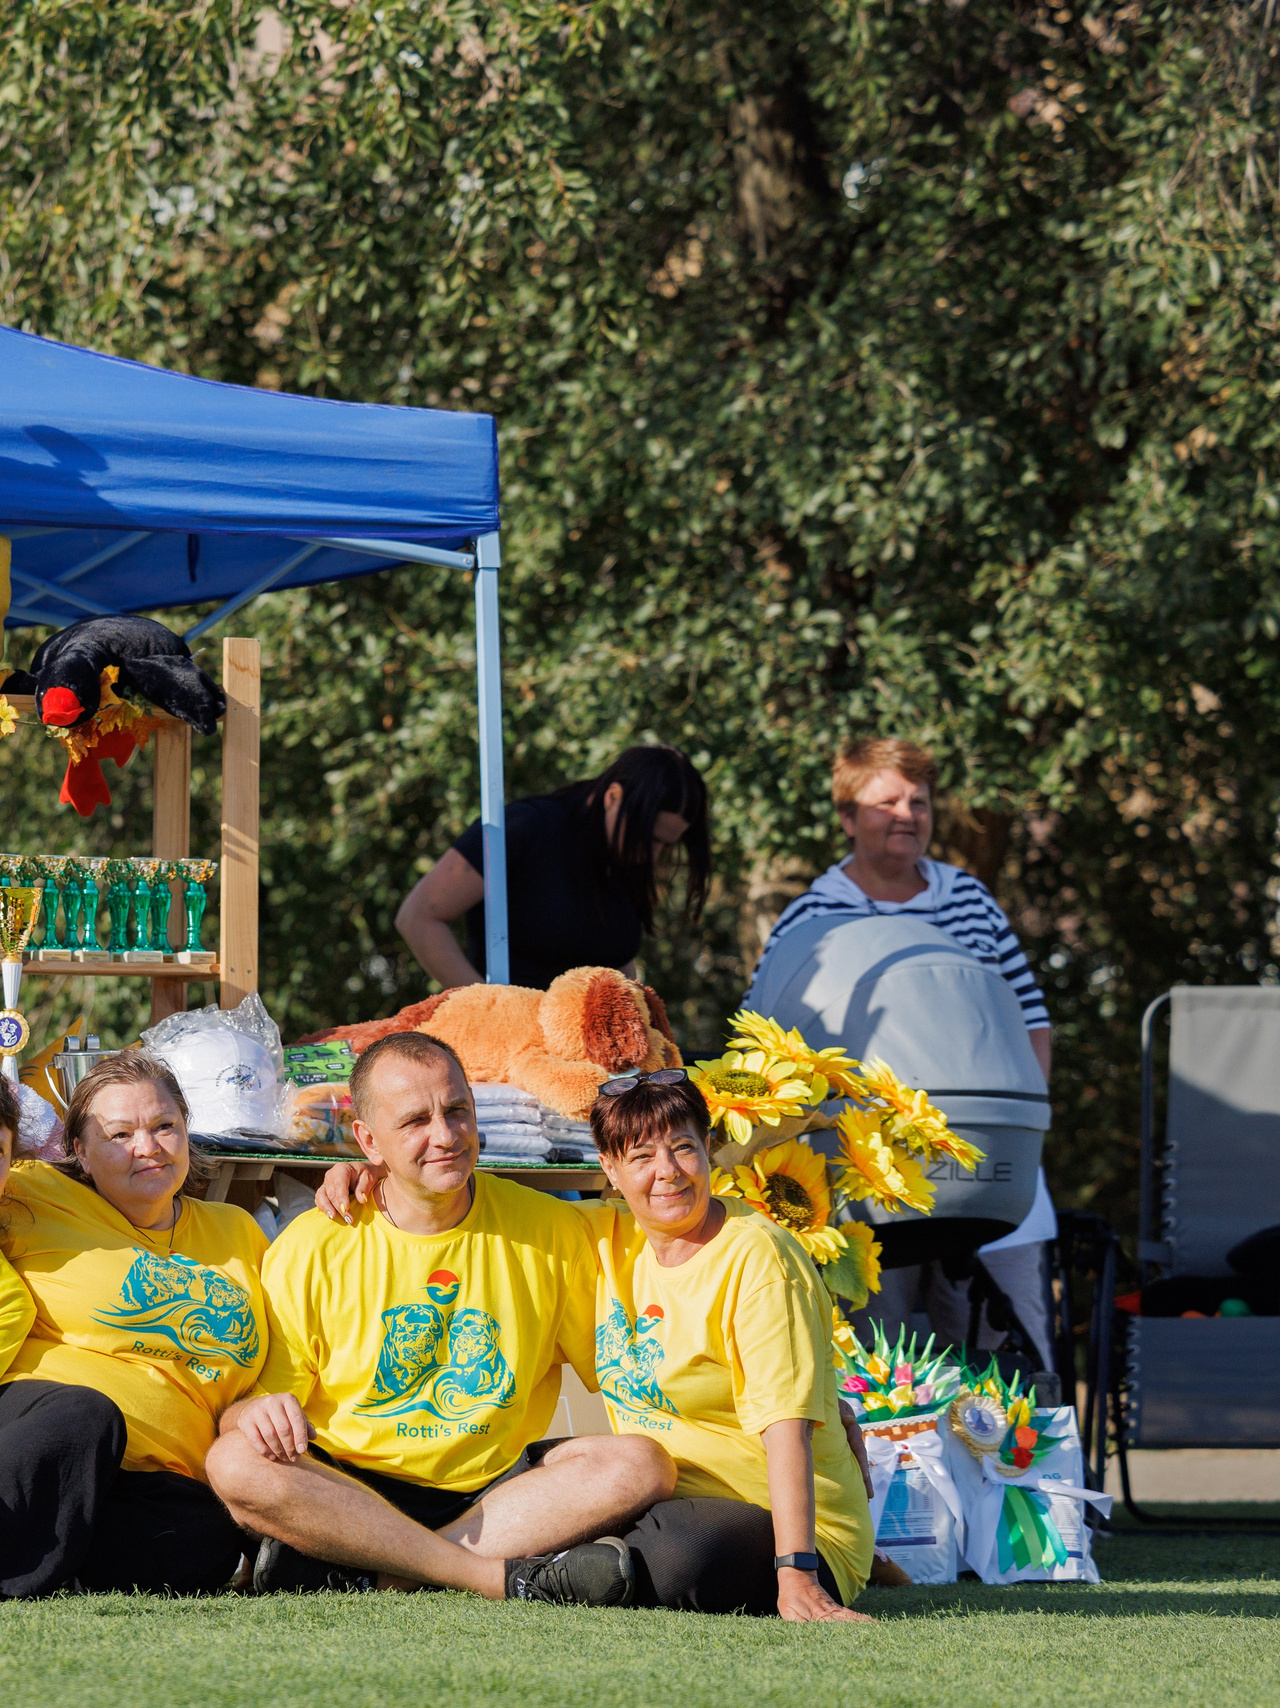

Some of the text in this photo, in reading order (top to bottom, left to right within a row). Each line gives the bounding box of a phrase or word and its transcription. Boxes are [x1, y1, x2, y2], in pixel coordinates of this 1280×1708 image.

[131, 1340, 222, 1383] Rotti's Rest
[396, 1422, 491, 1438] Rotti's Rest
[638, 1415, 674, 1431] Rest
